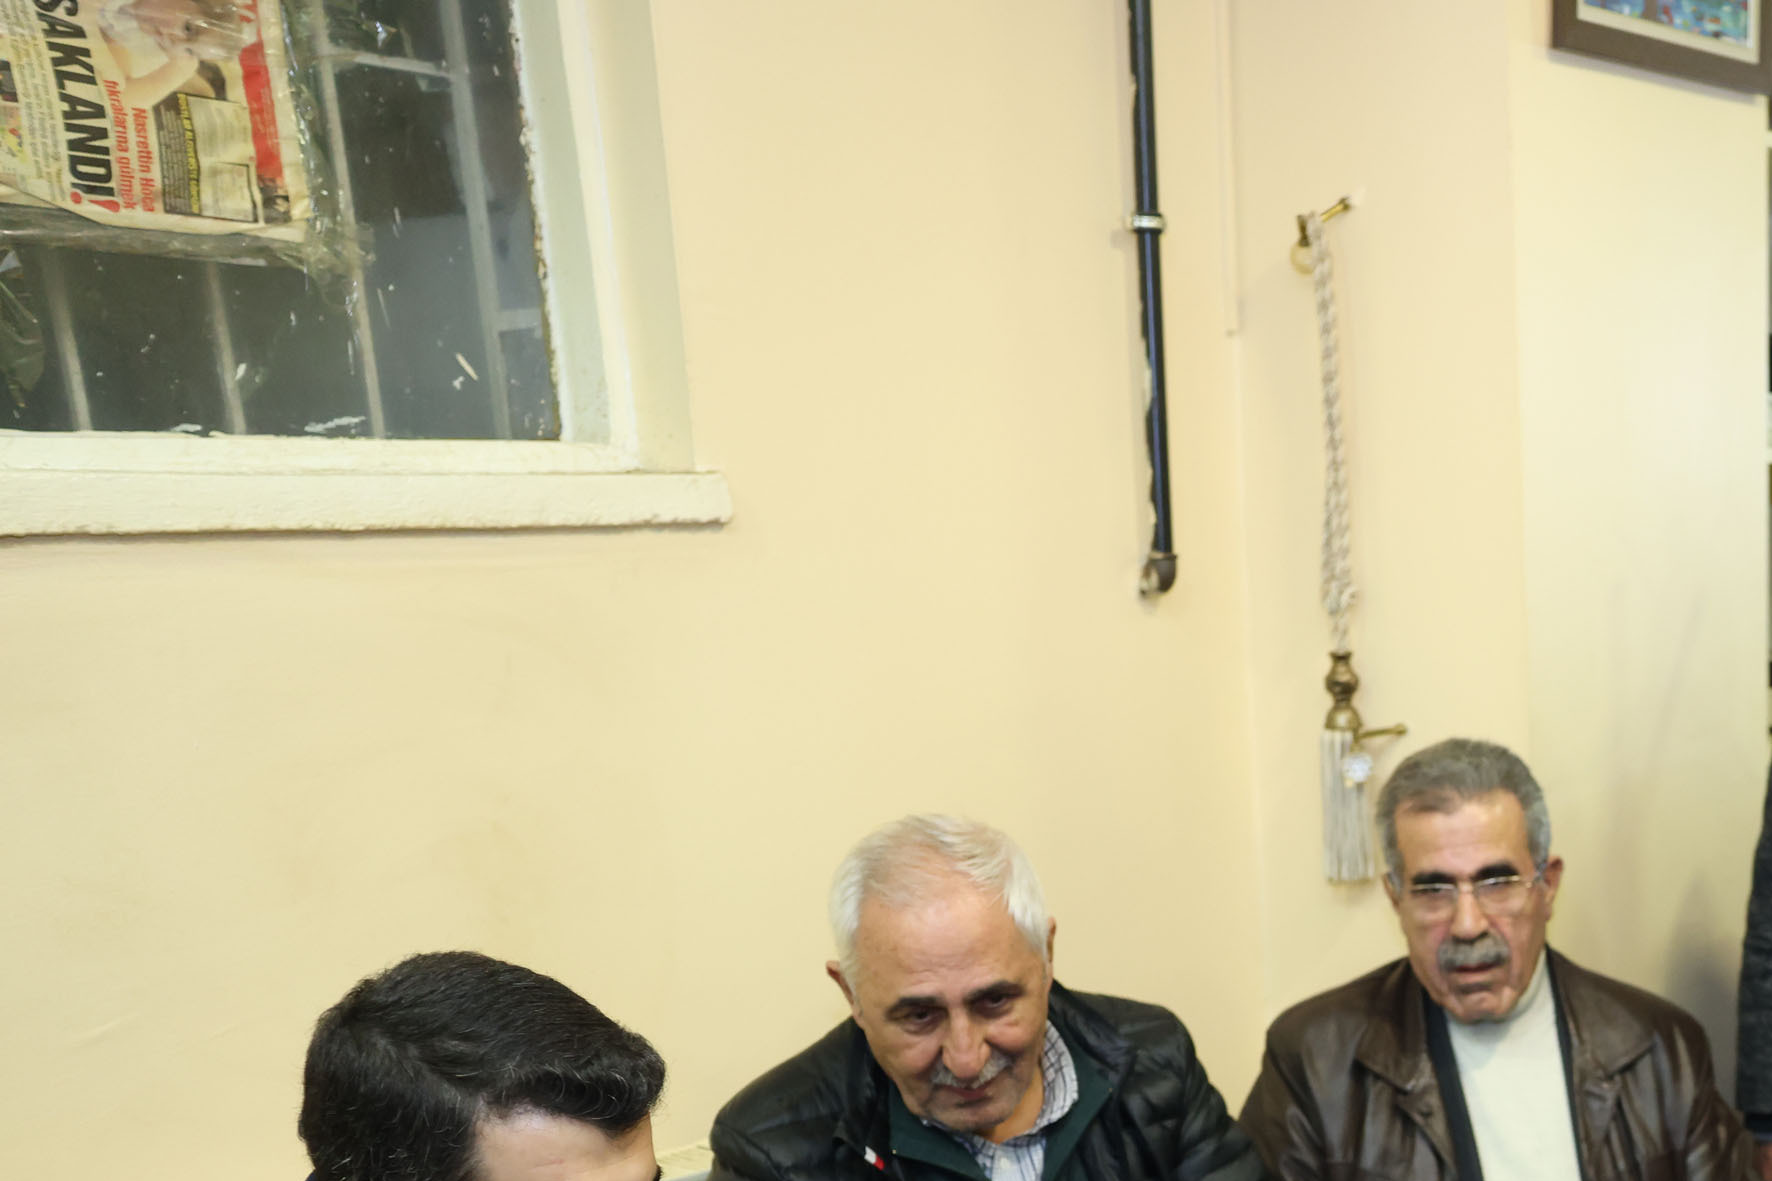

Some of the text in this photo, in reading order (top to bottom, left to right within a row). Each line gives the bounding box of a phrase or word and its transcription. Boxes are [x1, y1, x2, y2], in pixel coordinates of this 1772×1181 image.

[115, 155, 137, 210] gülmek
[131, 107, 156, 213] Nasrettin Hoca
